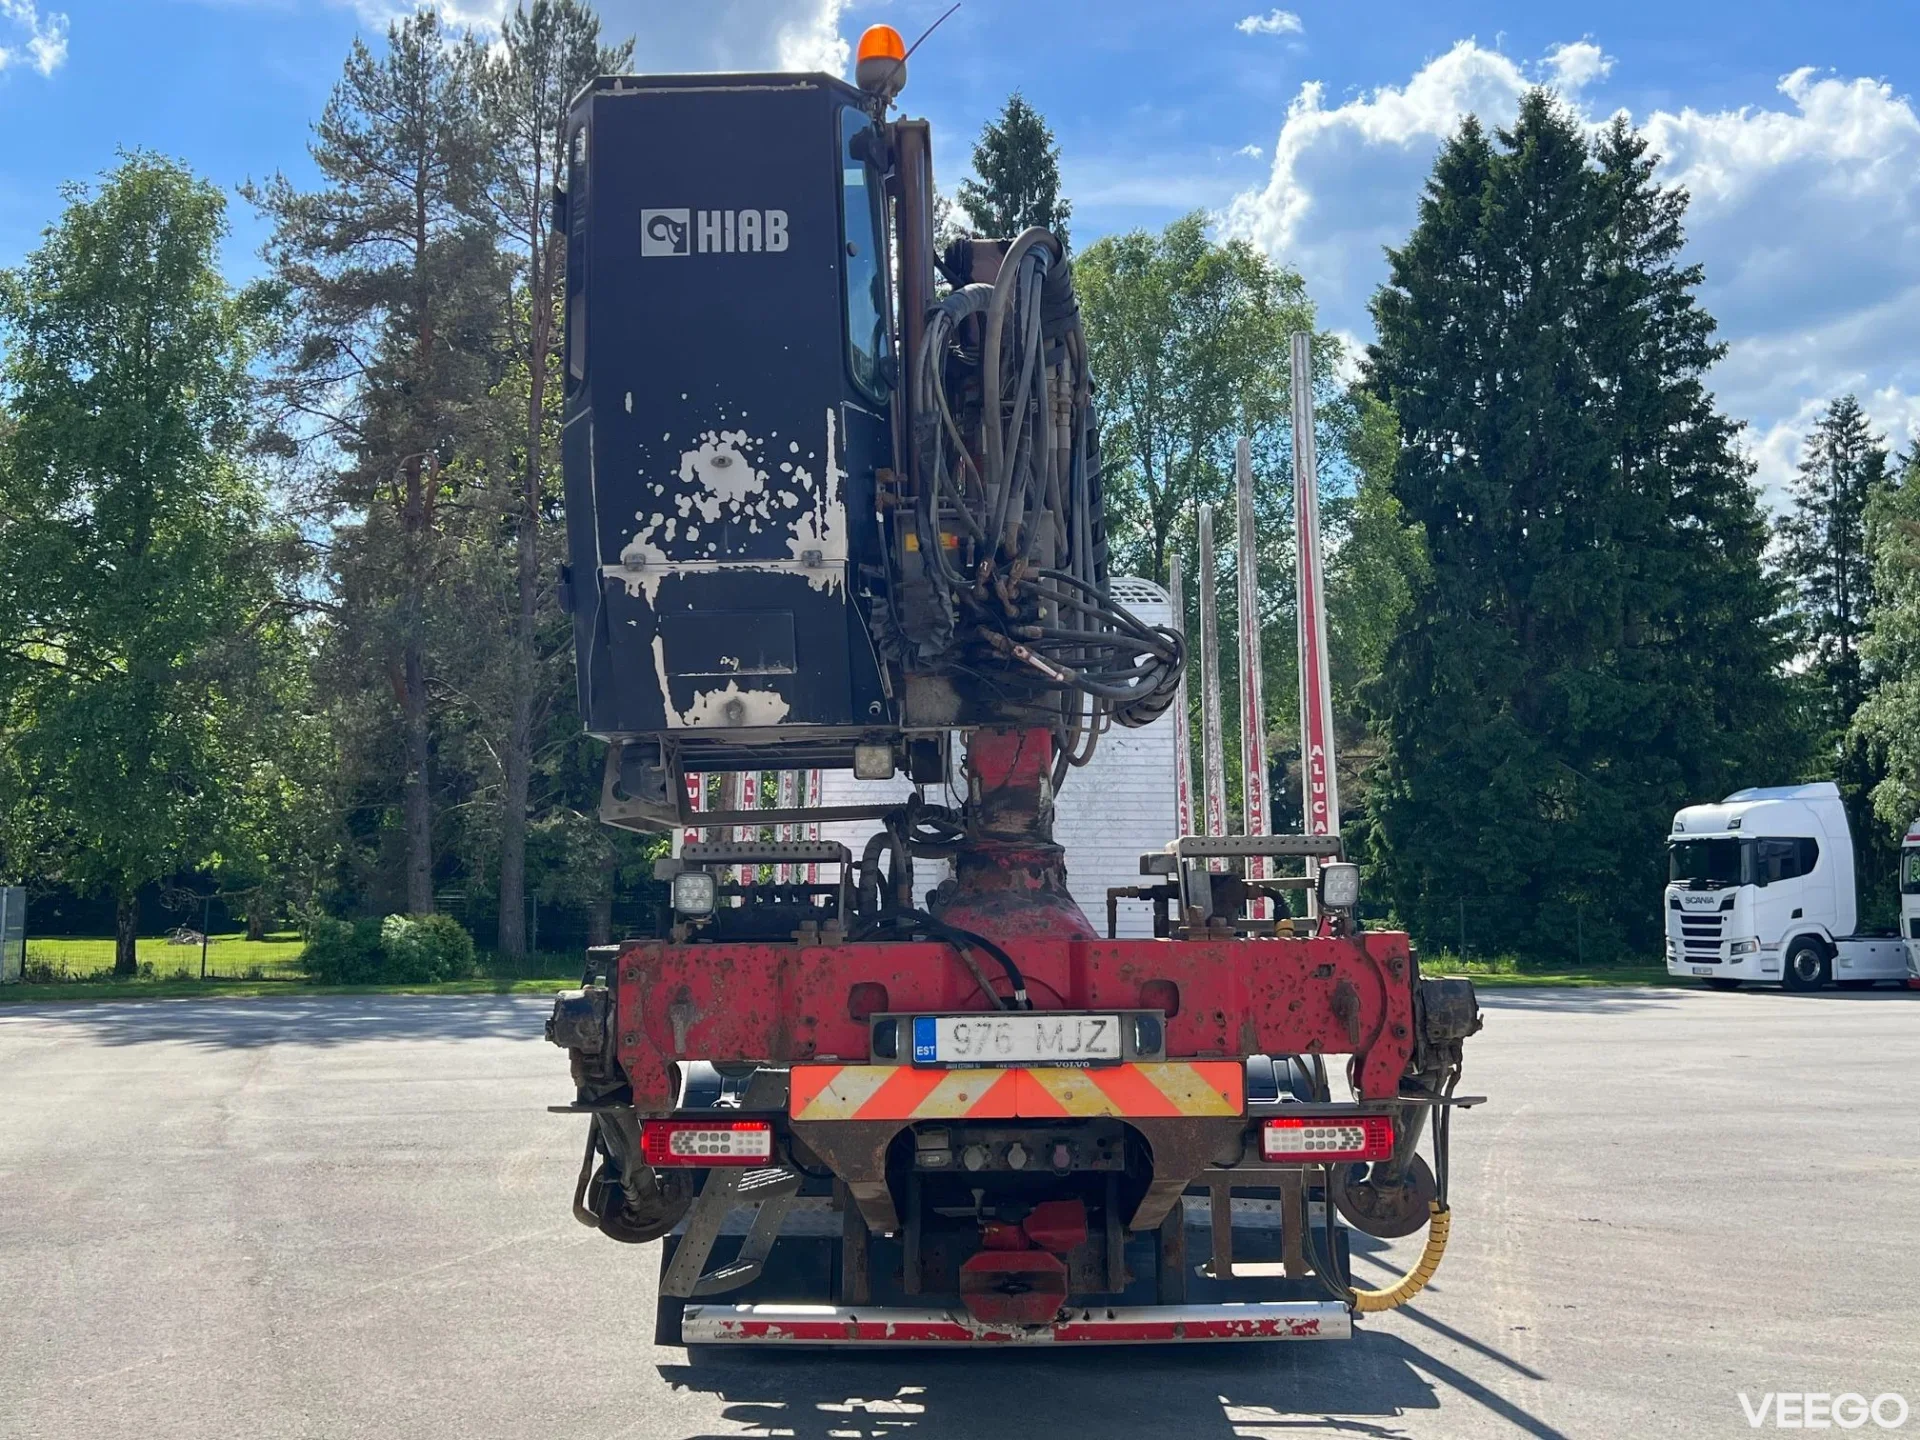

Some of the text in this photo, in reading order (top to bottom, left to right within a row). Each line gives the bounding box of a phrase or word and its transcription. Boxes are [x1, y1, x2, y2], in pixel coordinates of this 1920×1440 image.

[698, 209, 789, 253] HIAB
[1685, 896, 1715, 904] SCANIA
[953, 1020, 1108, 1054] 976 MJZ
[916, 1045, 935, 1056] EST
